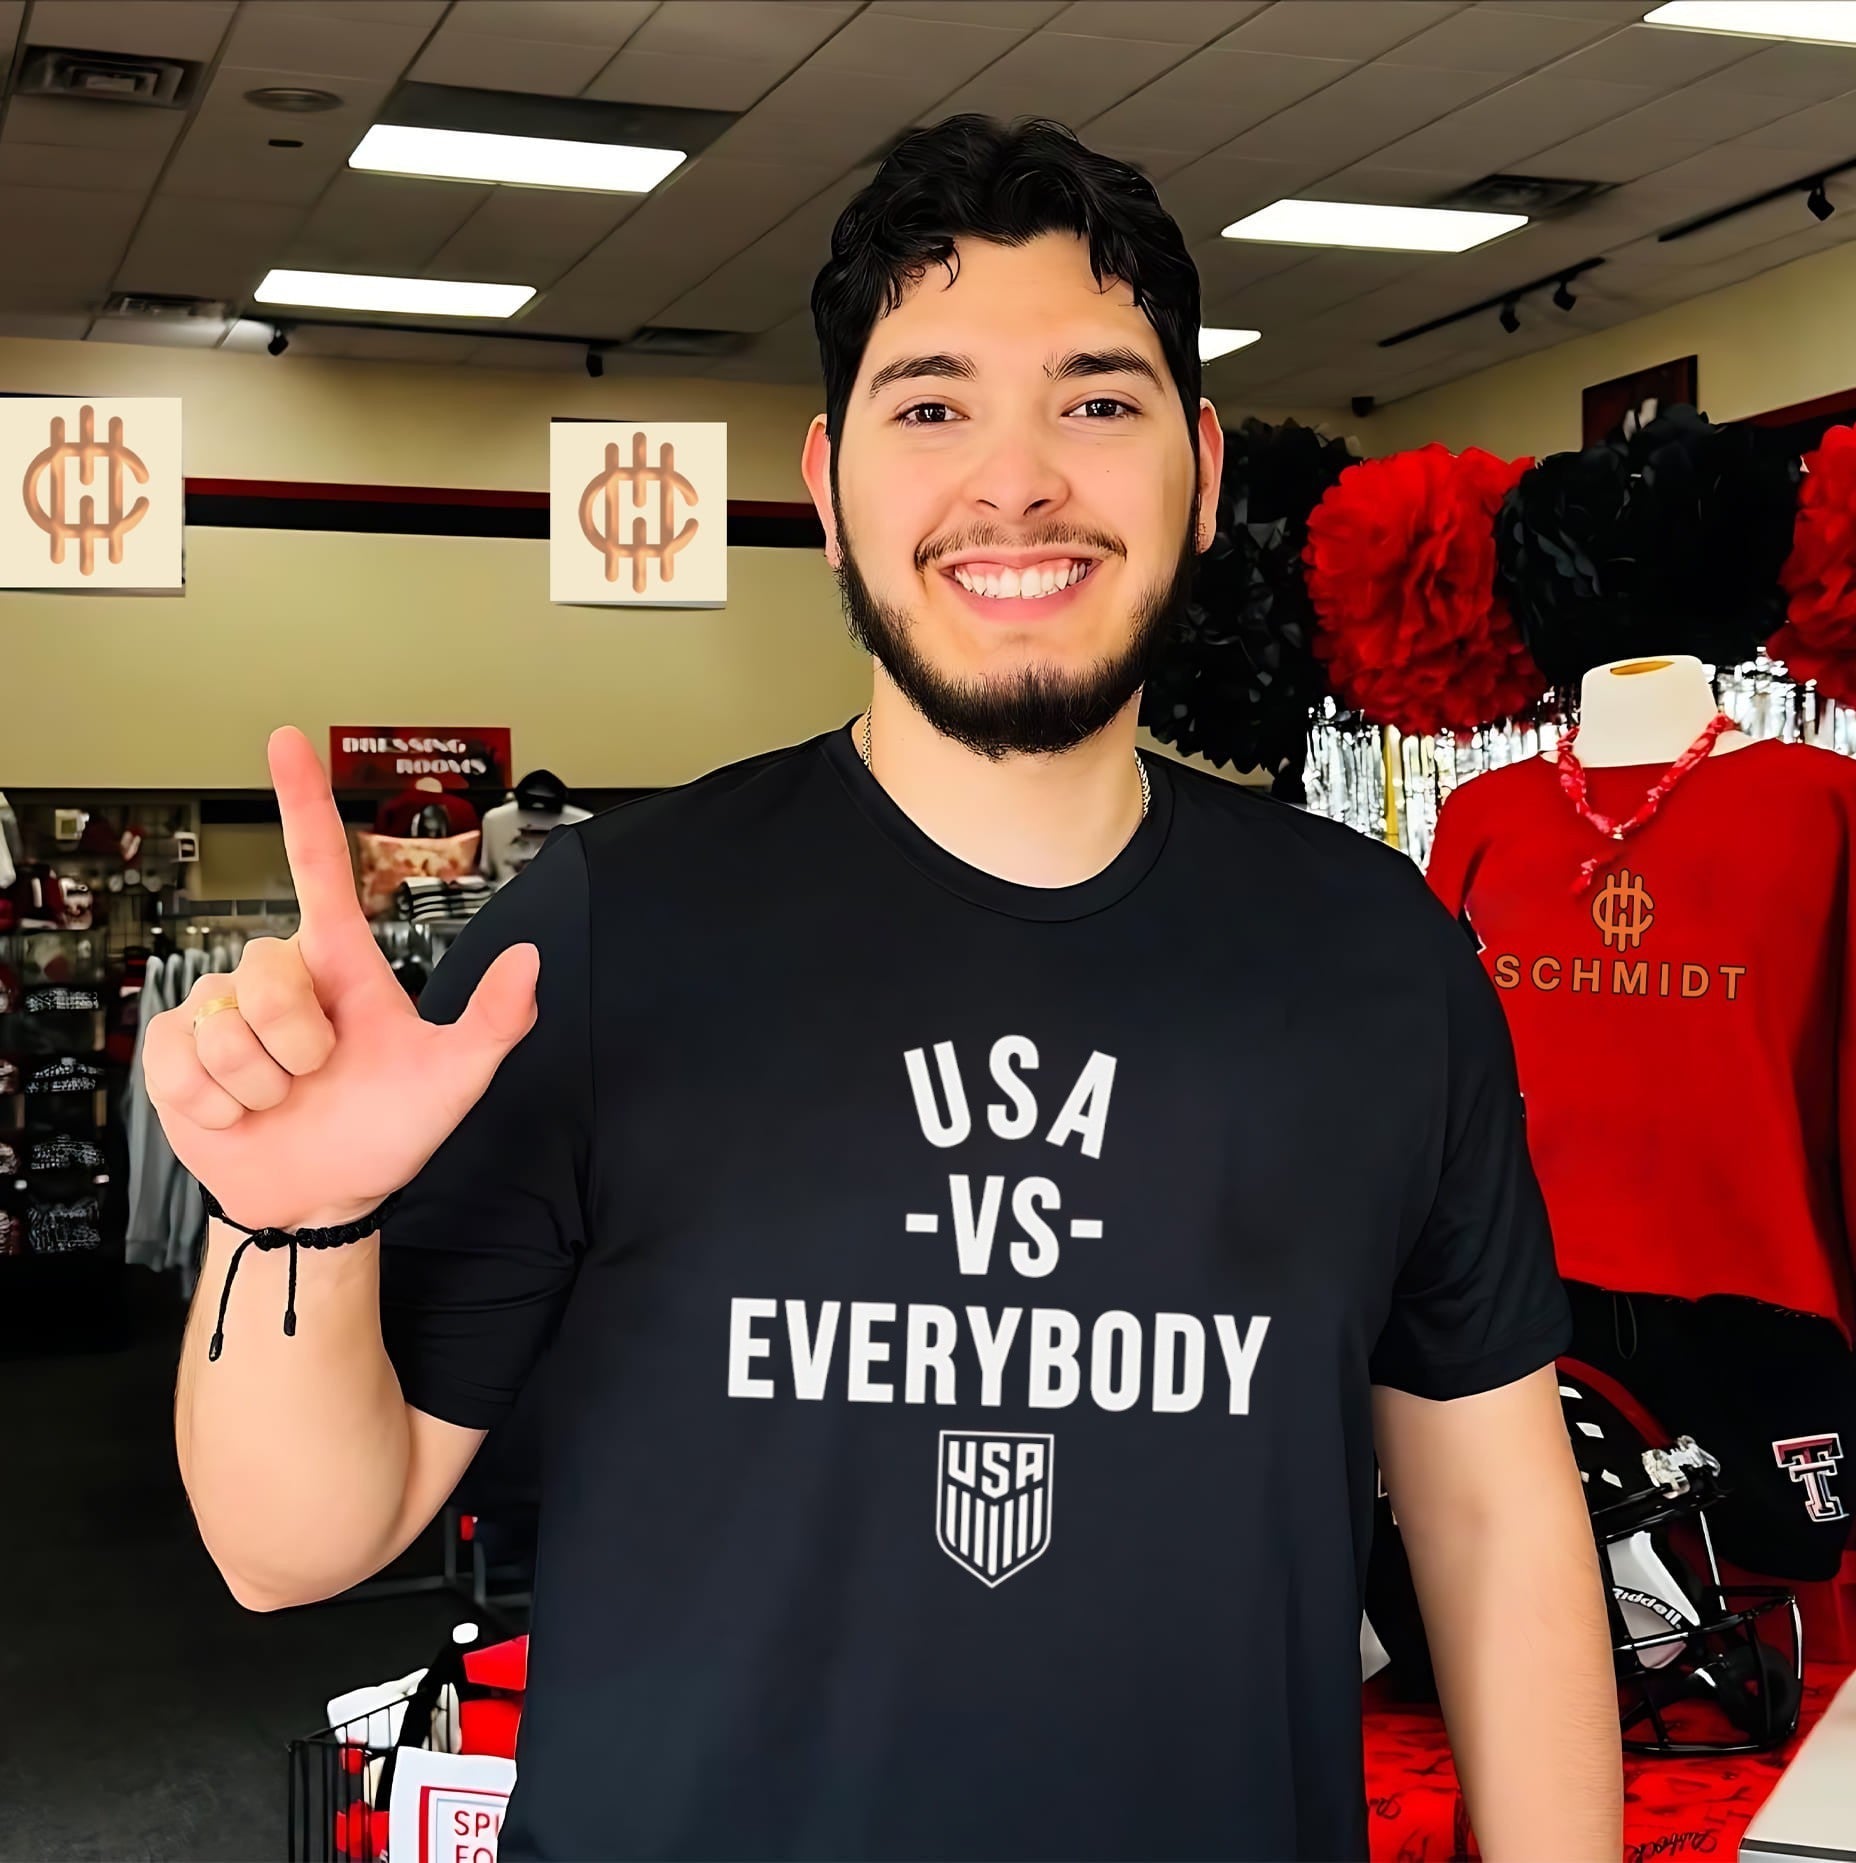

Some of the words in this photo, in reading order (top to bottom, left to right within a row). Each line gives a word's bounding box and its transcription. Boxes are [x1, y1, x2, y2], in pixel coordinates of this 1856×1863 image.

[342, 737, 467, 753] DRESSING
[396, 758, 487, 775] ROOMS
[1494, 953, 1747, 1000] SCHMIDT
[904, 1034, 1117, 1160] USA
[727, 1297, 1272, 1416] EVERYBODY
[948, 1441, 1045, 1499] USA
